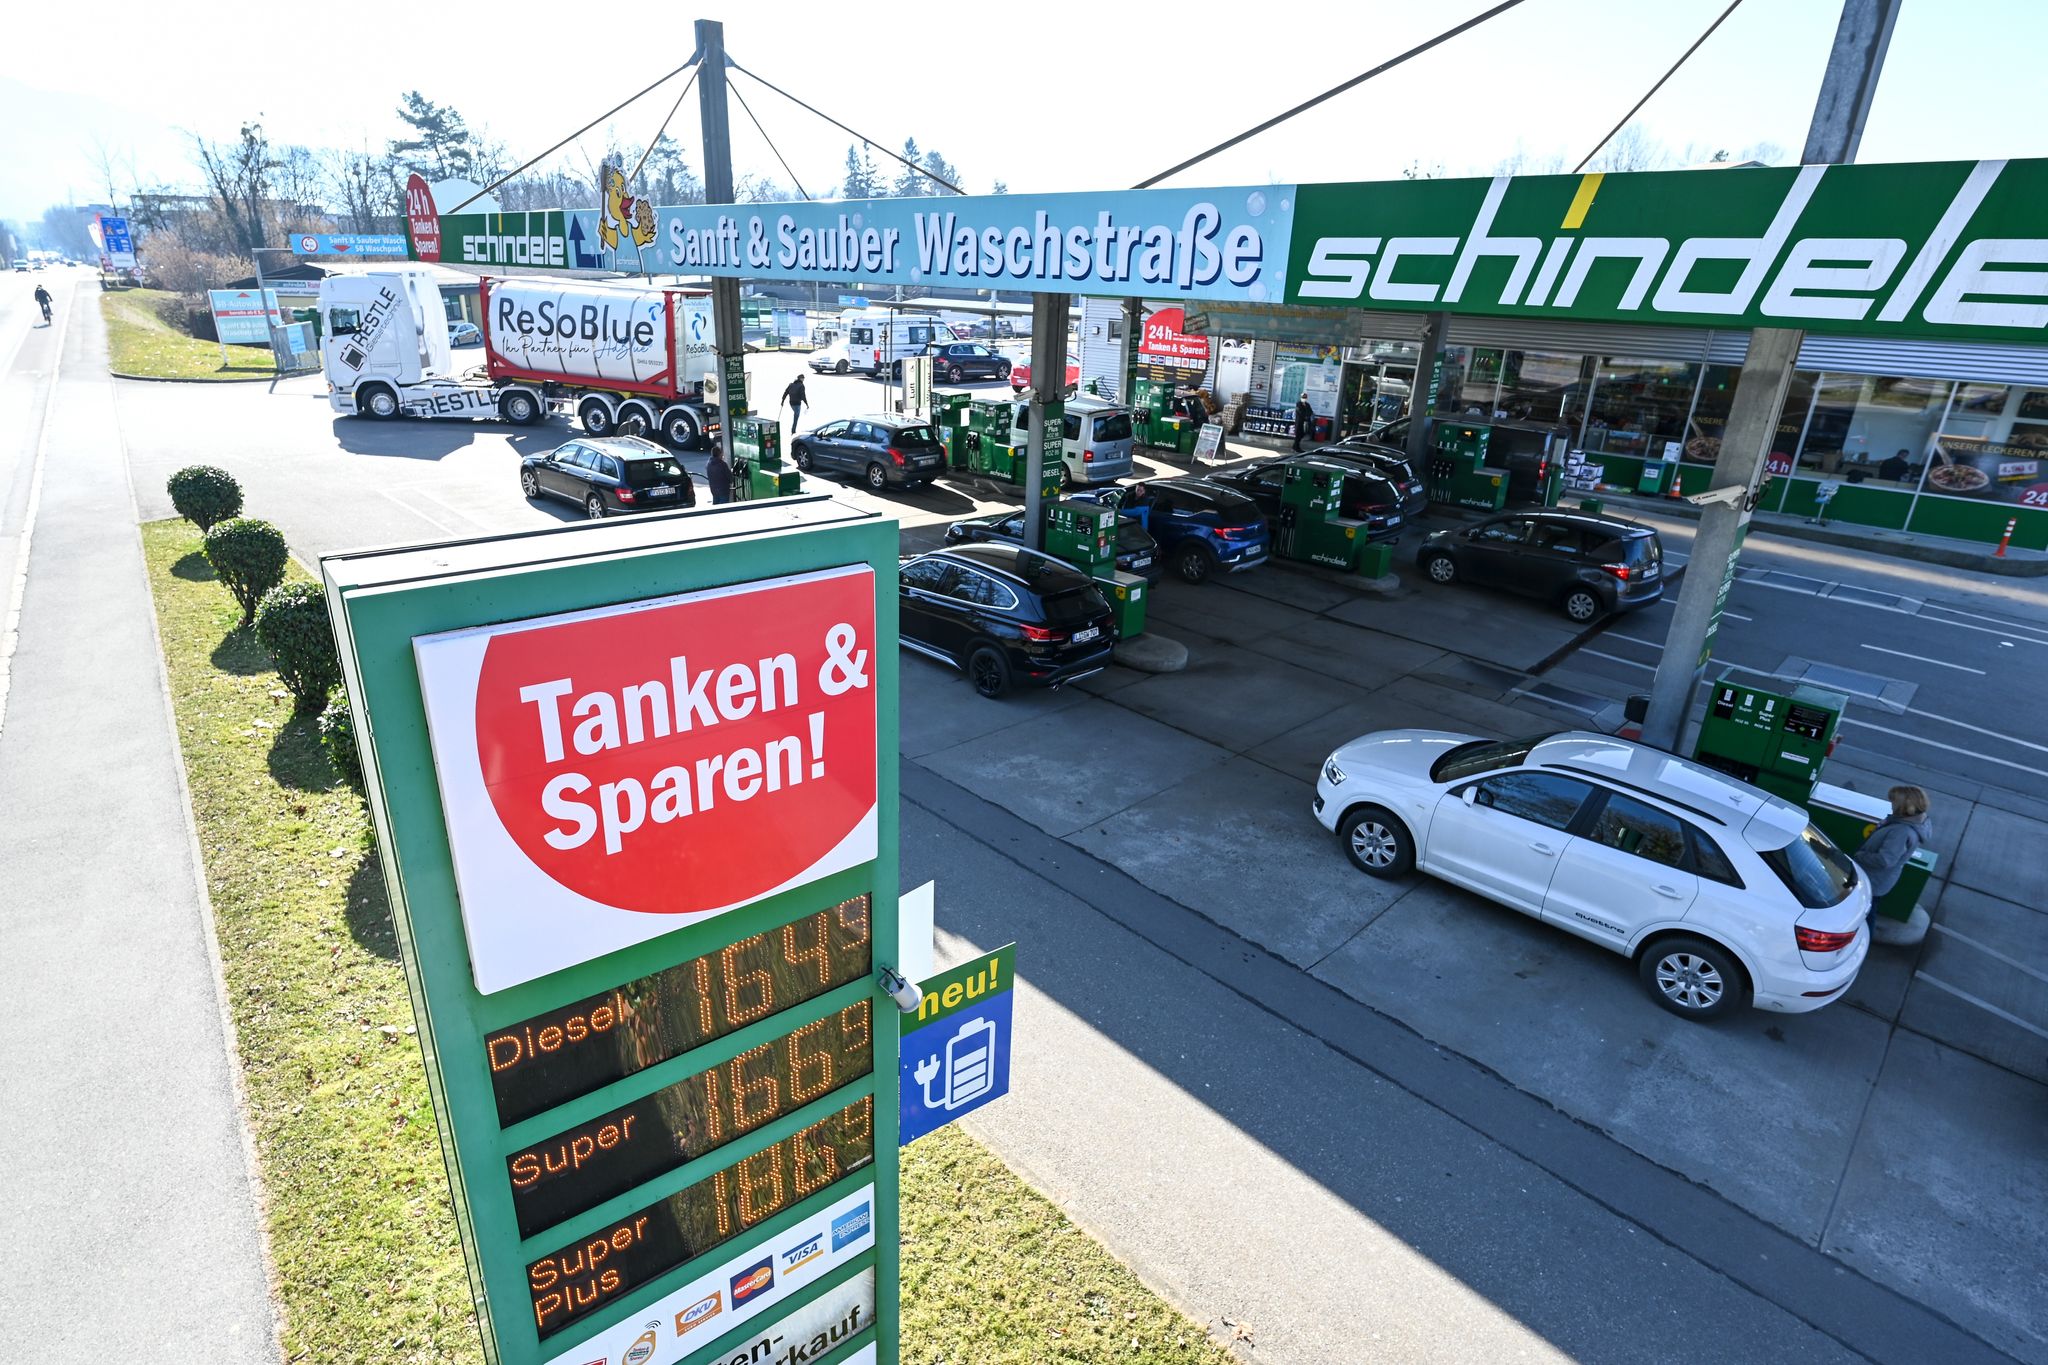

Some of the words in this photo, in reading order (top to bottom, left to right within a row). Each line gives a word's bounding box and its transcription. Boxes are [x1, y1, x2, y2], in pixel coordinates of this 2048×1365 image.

[406, 189, 421, 216] 24
[420, 189, 430, 215] h
[411, 218, 433, 234] Tanken
[432, 218, 440, 236] &
[329, 236, 349, 245] Sanft
[350, 236, 355, 245] &
[356, 236, 381, 245] Sauber
[414, 237, 439, 256] Sparen!
[463, 211, 565, 266] schindele
[669, 213, 742, 271] Sanft
[746, 213, 771, 270] &
[776, 212, 901, 274] Sauber
[914, 201, 1264, 287] Waschstraße
[1298, 157, 2048, 328] schindele
[354, 244, 364, 253] SB
[365, 244, 403, 254] Waschpark
[351, 286, 396, 348] RESTLE
[499, 297, 654, 347] ReSoBlue
[1148, 325, 1164, 340] 24
[1165, 326, 1173, 341] h
[517, 335, 567, 354] Partner
[1148, 341, 1171, 352] Tanken
[1171, 343, 1178, 353] &
[1179, 344, 1207, 356] Sparen!
[1043, 440, 1062, 450] SUPER
[1154, 439, 1177, 449] schindele
[1939, 440, 1980, 452] UNSERE
[1981, 444, 2035, 457] LECKEREN
[989, 469, 1012, 479] schindele
[1042, 468, 1061, 478] DIESEL
[1780, 463, 1790, 474] h
[2023, 490, 2048, 505] 24
[1086, 527, 1091, 535] 3
[1312, 553, 1348, 567] schindele
[518, 652, 799, 764] Tanken
[817, 622, 869, 697] &
[1717, 700, 1734, 708] Diesel
[1738, 705, 1753, 713] Super
[1758, 710, 1775, 718] Super
[1759, 715, 1771, 723] Plus
[1810, 728, 1818, 738] 1
[541, 710, 826, 856] Sparen!
[1574, 911, 1625, 935] quattro
[917, 957, 999, 1022] neu!
[486, 990, 626, 1073] Diesel
[510, 1113, 637, 1188] Super
[832, 1211, 869, 1236] AMERICAN
[839, 1217, 870, 1239] EXPRESS
[530, 1215, 649, 1292] Super
[788, 1242, 818, 1265] VISA
[733, 1267, 772, 1297] MasterCard
[534, 1265, 620, 1328] Plus
[683, 1299, 714, 1323] DKV
